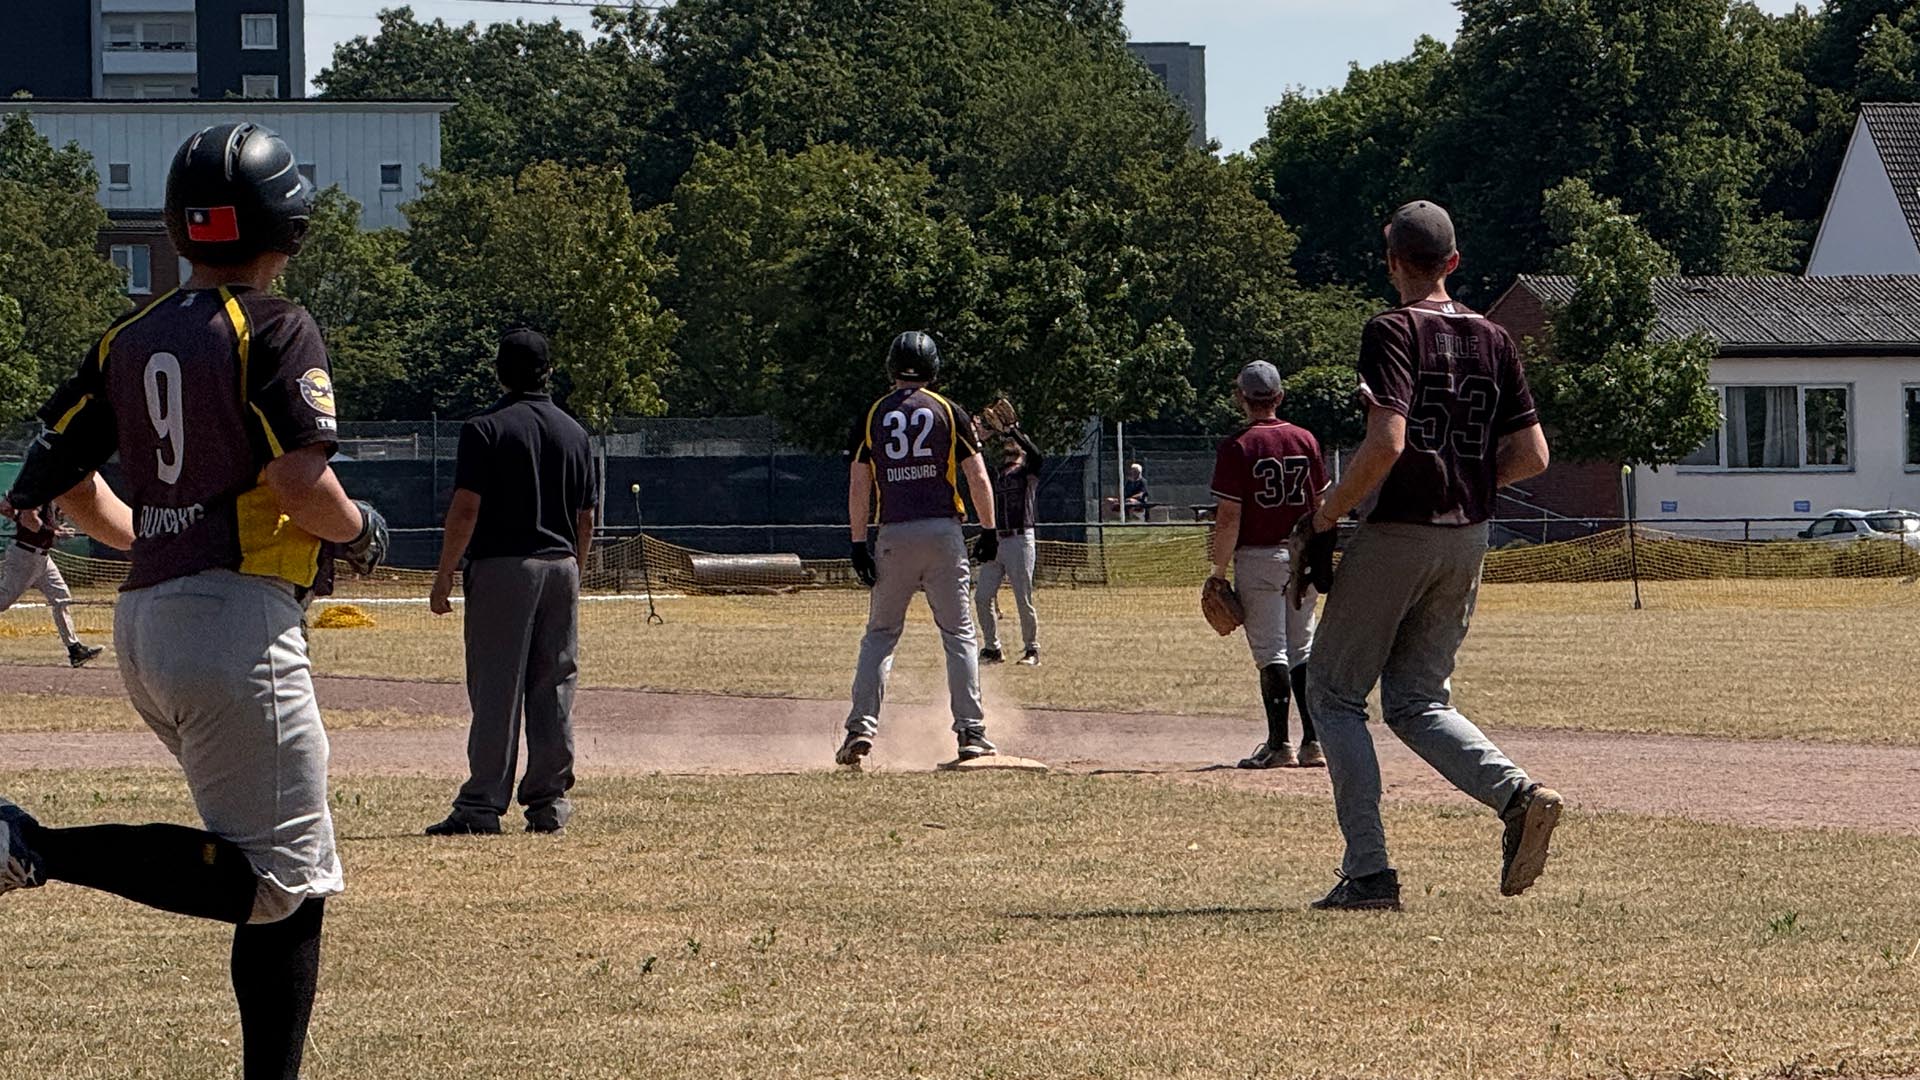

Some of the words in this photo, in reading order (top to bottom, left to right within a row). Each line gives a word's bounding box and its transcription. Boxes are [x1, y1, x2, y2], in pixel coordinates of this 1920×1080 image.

[143, 352, 184, 485] 9
[882, 407, 935, 460] 32
[1407, 371, 1500, 460] 53
[887, 464, 937, 482] DUISBURG
[1252, 455, 1310, 509] 37
